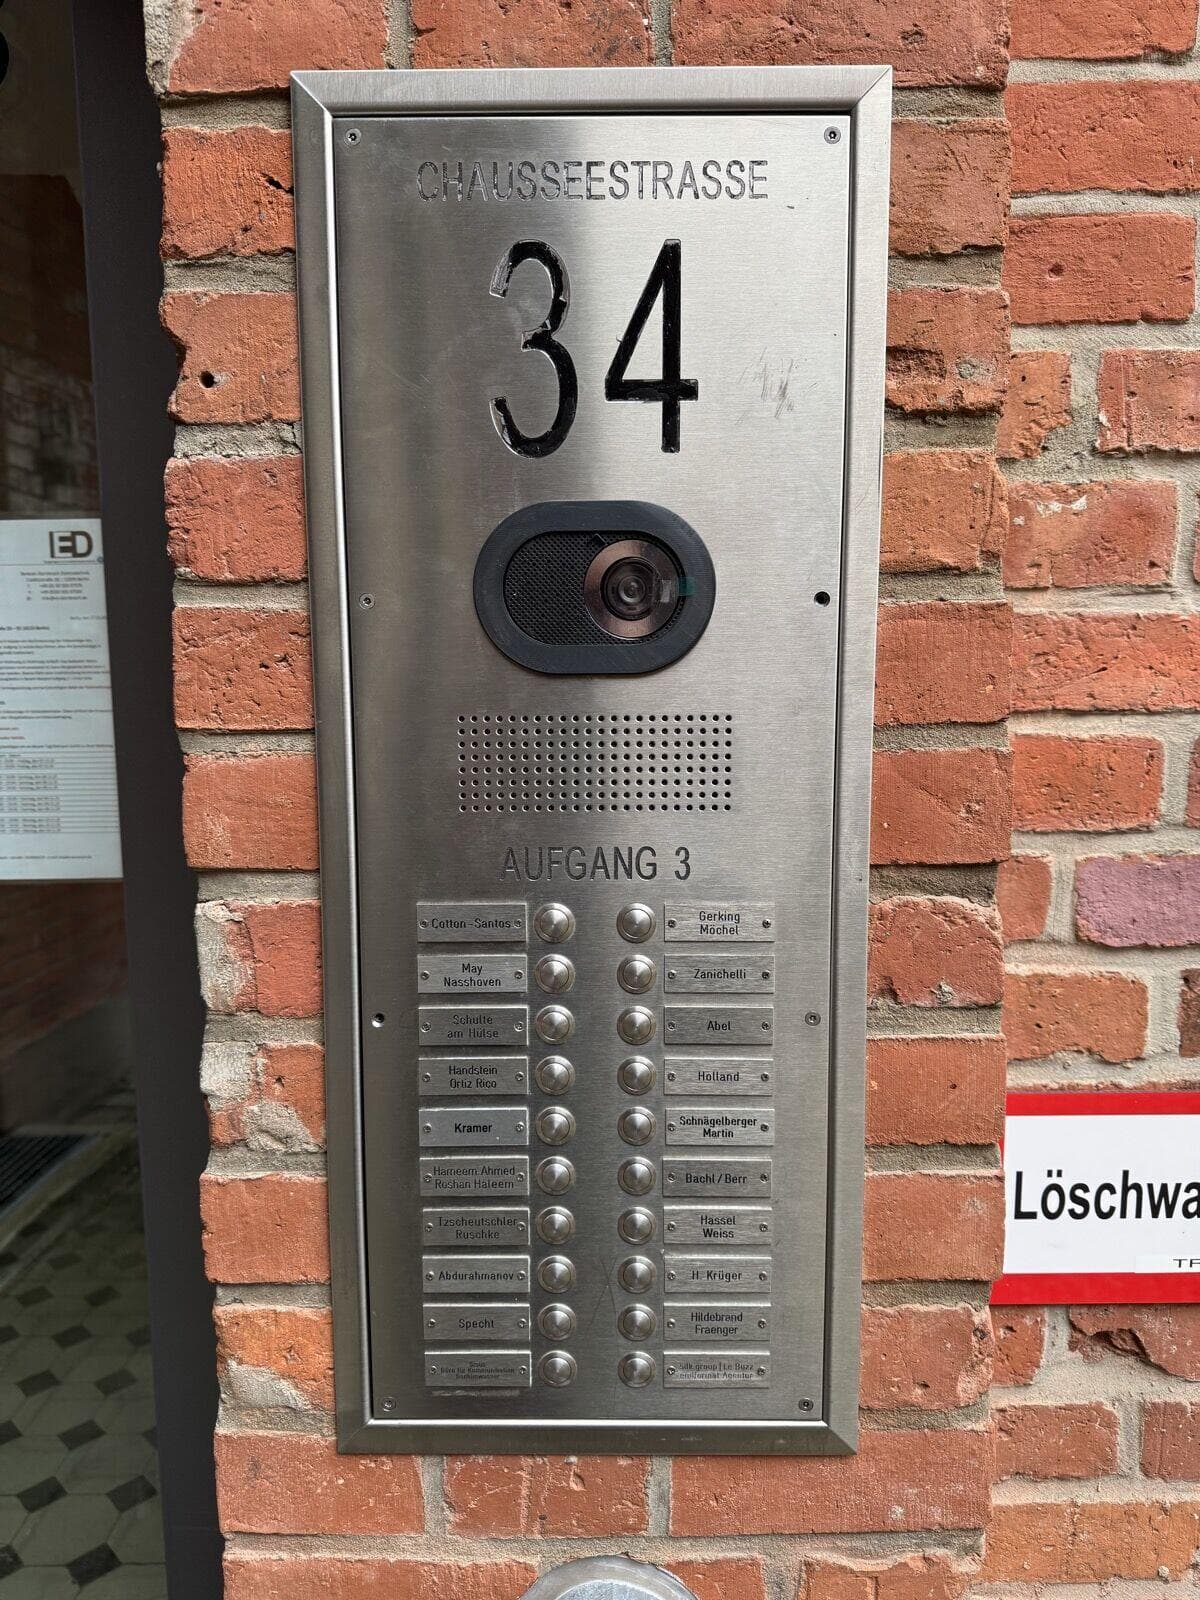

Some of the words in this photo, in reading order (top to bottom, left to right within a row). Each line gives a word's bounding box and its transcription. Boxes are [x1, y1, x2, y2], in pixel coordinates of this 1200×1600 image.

[416, 159, 770, 201] CHAUSSEESTRASSE
[489, 238, 699, 459] 34
[500, 846, 658, 881] AUFGANG
[674, 846, 691, 881] 3
[699, 911, 741, 924] Gerking
[699, 923, 739, 935] Möchel
[461, 963, 483, 976] May
[694, 969, 747, 980] Zanichelli
[443, 976, 502, 987] Nasshoven
[452, 1014, 493, 1026] Schulte
[707, 1020, 731, 1031] Abel
[446, 1030, 464, 1039] am
[468, 1027, 500, 1039] Hülse
[448, 1065, 498, 1077] Handstein
[698, 1071, 740, 1082] Holland
[449, 1078, 473, 1089] Ortiz
[476, 1078, 497, 1089] Rico
[454, 1122, 493, 1133] Kramer
[679, 1116, 757, 1128] Schnägelberger
[702, 1128, 734, 1138] Martin
[481, 1166, 516, 1176] Ahmed
[434, 1179, 472, 1189] Roshan
[474, 1179, 514, 1189] Haleem
[685, 1173, 714, 1184] Bachl
[724, 1173, 748, 1184] Berr
[1013, 1169, 1200, 1220] Löschwa
[438, 1216, 518, 1227] Tzscheutschler
[700, 1216, 737, 1226] Hassel
[456, 1229, 500, 1239] Ruschke
[702, 1228, 734, 1238] Weiss
[438, 1270, 514, 1282] Abdurahmanov
[706, 1270, 742, 1284] Krüger
[691, 1312, 743, 1323] Hildebrand
[458, 1318, 495, 1331] Specht
[695, 1325, 738, 1336] Fraenger
